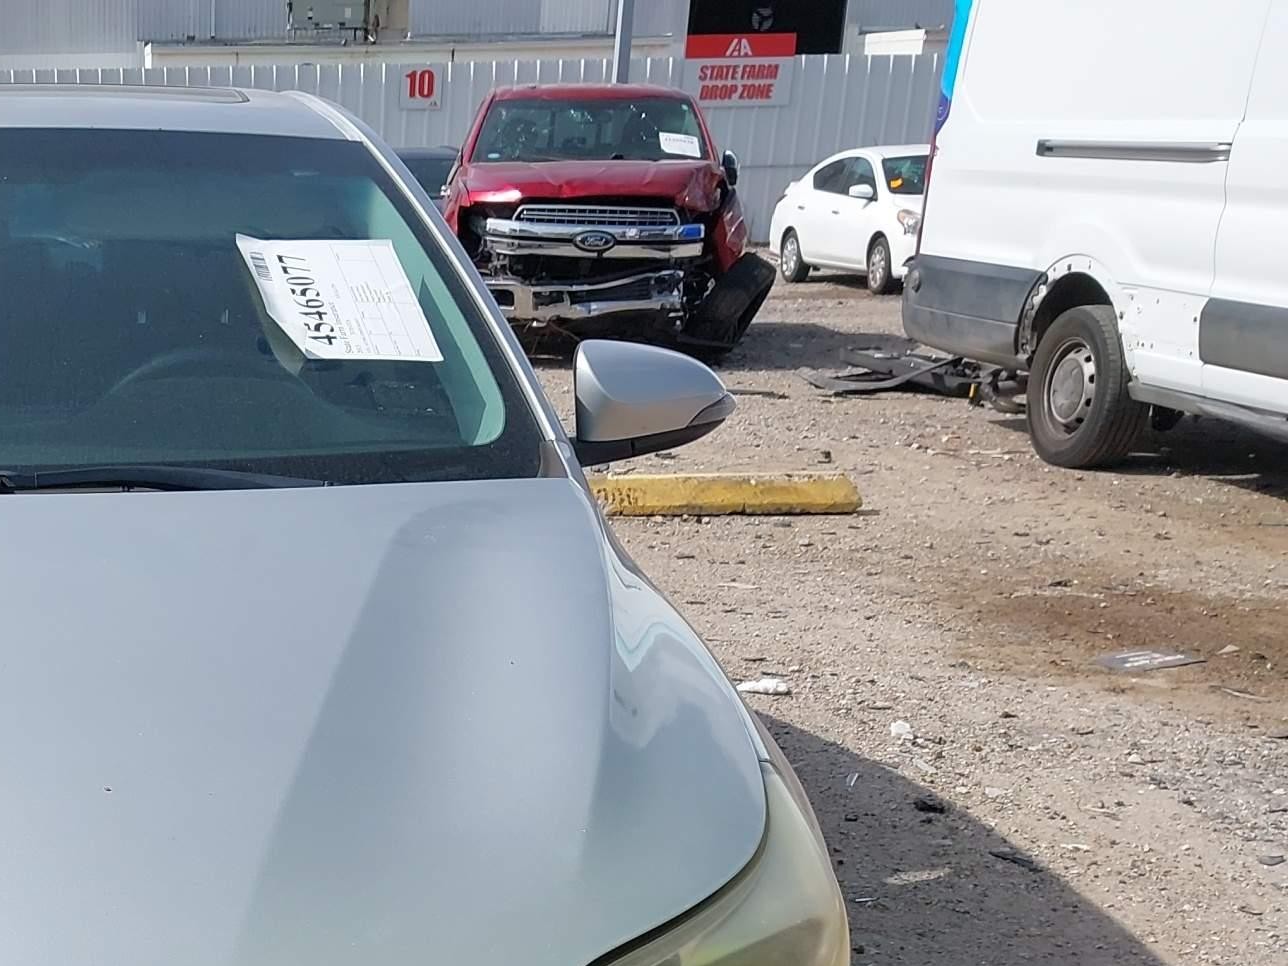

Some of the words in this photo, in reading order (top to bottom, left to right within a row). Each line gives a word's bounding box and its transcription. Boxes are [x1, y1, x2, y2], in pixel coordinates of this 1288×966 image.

[699, 65, 738, 80] STATE
[740, 64, 779, 80] FARM
[405, 70, 434, 98] 10
[700, 85, 738, 100] DROP
[740, 84, 774, 99] ZONE
[277, 254, 337, 345] 45465077
